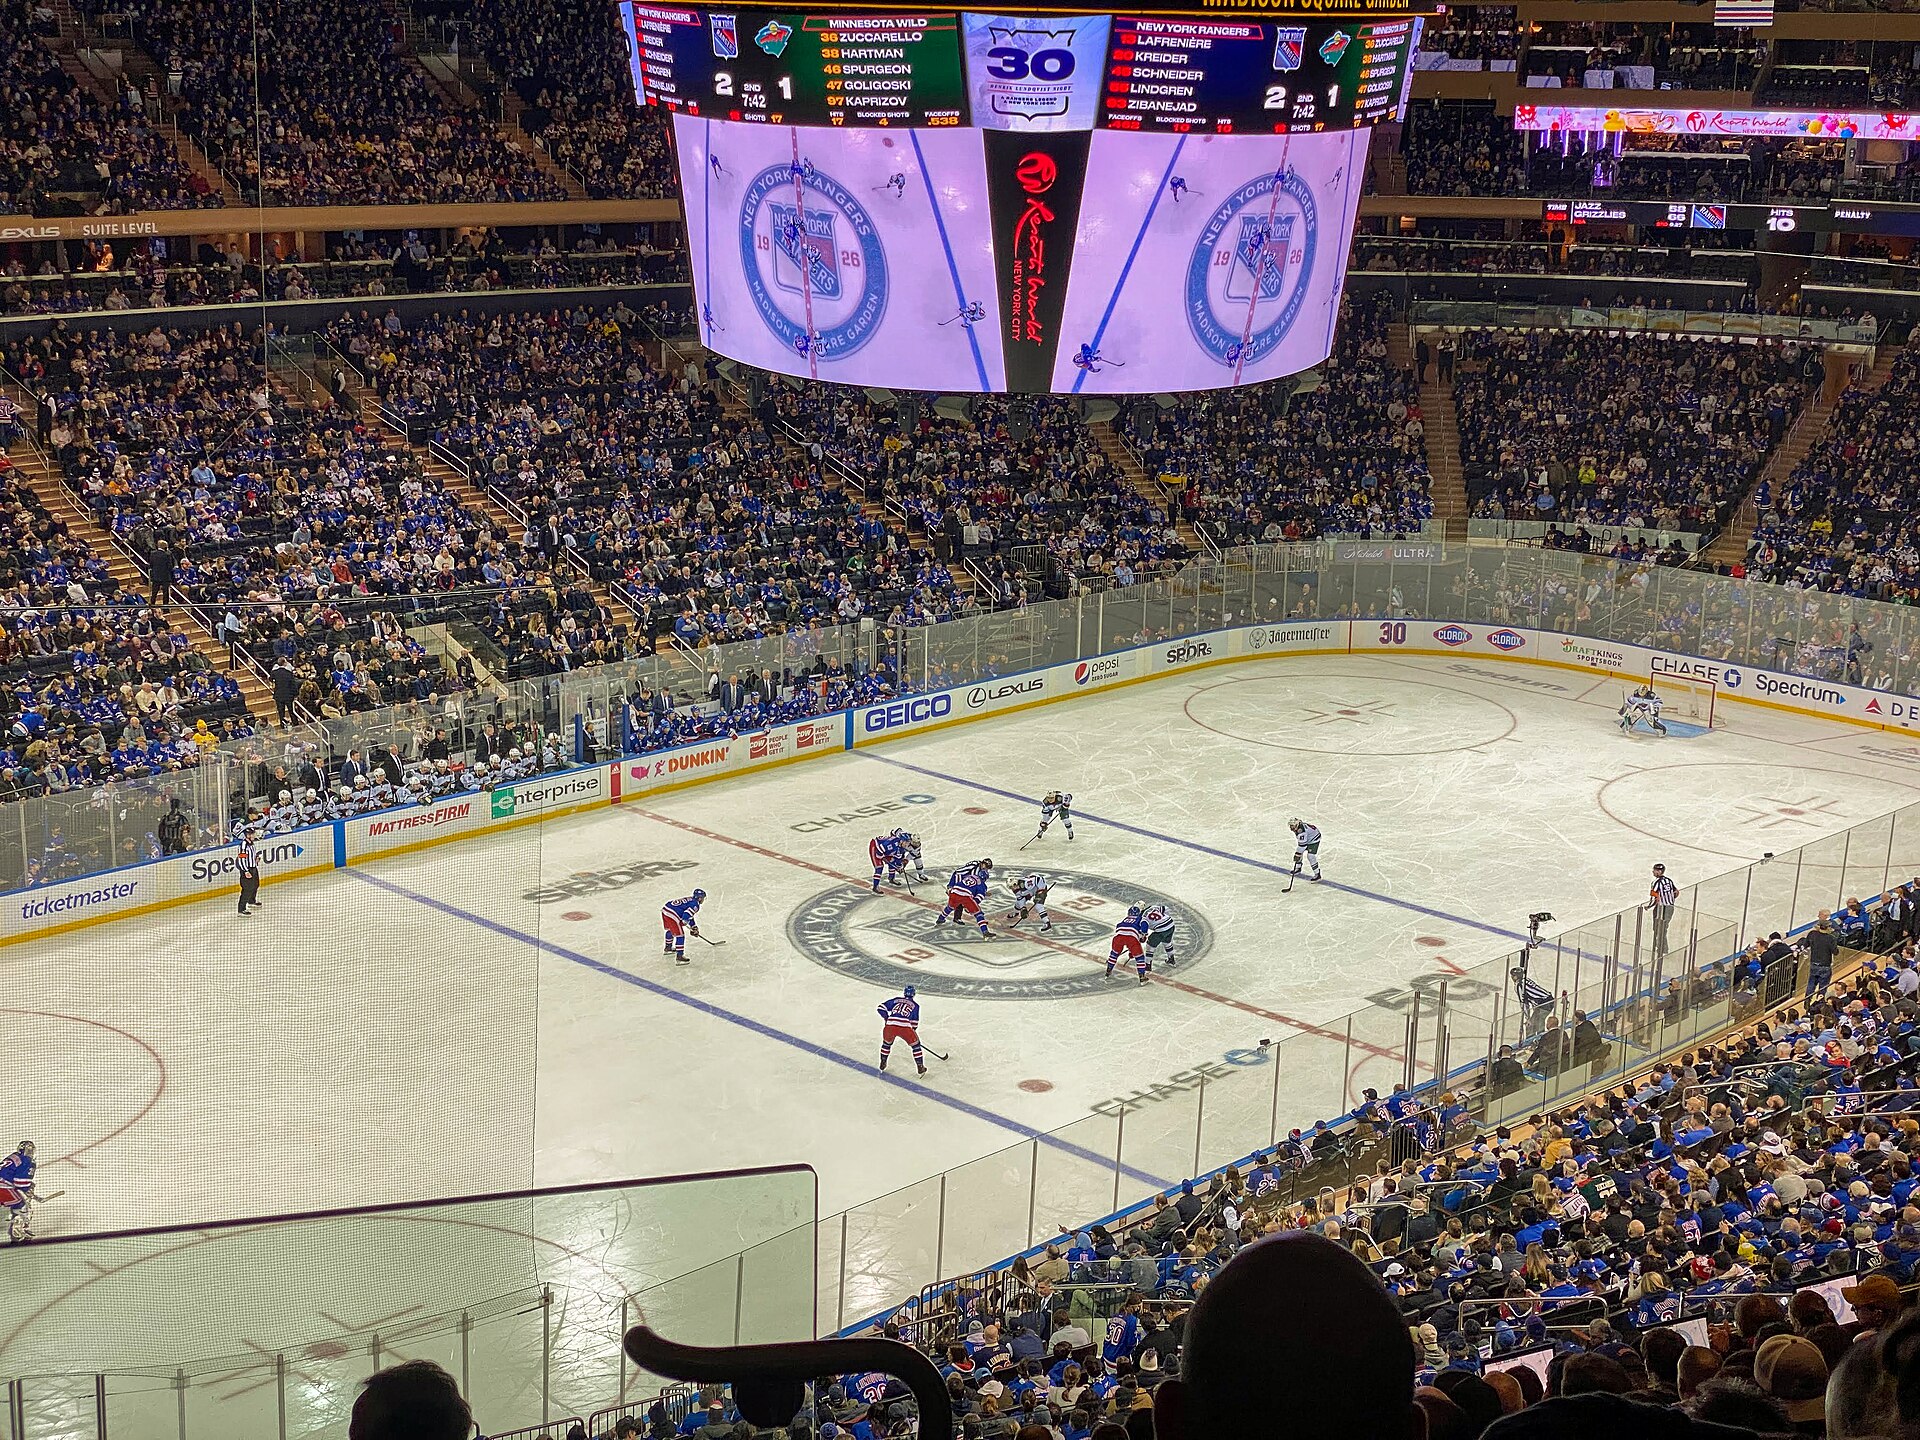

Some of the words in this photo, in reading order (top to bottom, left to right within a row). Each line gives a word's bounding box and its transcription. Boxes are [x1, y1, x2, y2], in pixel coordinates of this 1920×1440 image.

[829, 19, 895, 28] MINNESOTA
[896, 19, 928, 27] WILD
[1136, 22, 1166, 32] NEW
[1167, 23, 1198, 34] YORK
[1198, 26, 1250, 36] RANGERS
[820, 33, 838, 42] 36
[839, 32, 923, 42] ZUCCARELLO
[1137, 35, 1212, 49] LAFRENIÈRE
[821, 49, 839, 58] 38
[841, 48, 904, 58] HARTMAN
[1135, 51, 1188, 64] KREIDER
[823, 65, 841, 74] 46
[842, 64, 912, 75] SPURGEON
[986, 46, 1076, 82] 30
[1133, 68, 1204, 81] SCHNEIDER
[714, 73, 734, 96] 2
[743, 84, 761, 92] 2ND
[778, 77, 792, 99] 1
[826, 81, 843, 90] 47
[844, 80, 911, 91] GOLIGOSKI
[1130, 84, 1193, 96] LINDGREN
[742, 94, 767, 108] 7:42
[827, 97, 844, 106] 97
[846, 96, 907, 106] KAPRIZOV
[1264, 86, 1287, 110] 2
[1297, 95, 1314, 103] 2ND
[1327, 85, 1339, 108] 1
[1128, 100, 1197, 112] ZIBANEJAD
[1292, 105, 1315, 119] 7:42
[771, 115, 783, 123] 17
[831, 117, 844, 126] 17
[878, 118, 889, 126] 4
[927, 117, 959, 126] .538
[1752, 117, 1789, 127] World
[1314, 122, 1324, 131] 17
[743, 190, 759, 228] NEW
[758, 168, 792, 192] YORK
[1203, 205, 1234, 247] NEW
[1236, 179, 1273, 202] YORK
[1574, 202, 1602, 210] JAZZ
[1669, 205, 1686, 213] 58
[1770, 208, 1794, 217] HITS
[1574, 210, 1627, 219] GRIZZLIES
[1699, 206, 1725, 229] RANGERS
[1835, 211, 1871, 219] PENALTY
[83, 224, 119, 236] SUITE
[122, 222, 159, 234] LEVEL
[1766, 218, 1795, 232] 10
[0, 226, 60, 239] EXUS
[757, 235, 770, 250] 19
[841, 251, 860, 267] 26
[1213, 251, 1230, 266] 19
[1290, 249, 1302, 264] 26
[1013, 260, 1022, 286] NEW
[752, 280, 790, 337] MADISON
[1012, 287, 1022, 319] YORK
[847, 292, 879, 341] GARDEN
[1274, 287, 1303, 336] GARDEN
[1011, 319, 1021, 342] CITY
[1195, 300, 1226, 349] MADISON
[1344, 545, 1385, 559] Michelob
[1394, 548, 1434, 558] ULTRA
[1379, 622, 1407, 645] 30
[1438, 629, 1468, 642] CLOROX
[1491, 634, 1521, 647] CLOROX
[1563, 645, 1623, 661] DRAFTKINGS
[1092, 656, 1119, 676] pepsi
[1577, 654, 1622, 668] SPORTSBOOK
[1105, 671, 1118, 680] SUGAR
[1651, 656, 1719, 682] CHASE
[1447, 664, 1562, 690] Spectrum
[988, 678, 1043, 701] LEXUS
[1756, 674, 1840, 704] Spectrum
[865, 694, 951, 733] GEICO
[815, 724, 834, 733] PEOPLE
[815, 731, 828, 739] WHO
[769, 734, 788, 743] PEOPLE
[769, 741, 782, 749] WHO
[668, 747, 730, 773] DUNKIN'
[499, 777, 599, 810] enterprise
[790, 800, 907, 834] CHASE
[192, 843, 297, 882] Sperum
[22, 881, 138, 919] ticketmaster
[803, 889, 873, 925] YORK
[1062, 895, 1106, 911] 26
[803, 929, 861, 965] NEW
[888, 948, 935, 965] 19
[953, 981, 1093, 993] MADISON
[892, 1002, 913, 1018] 45
[1089, 1061, 1237, 1119] CHASE
[1105, 1324, 1125, 1346] 30
